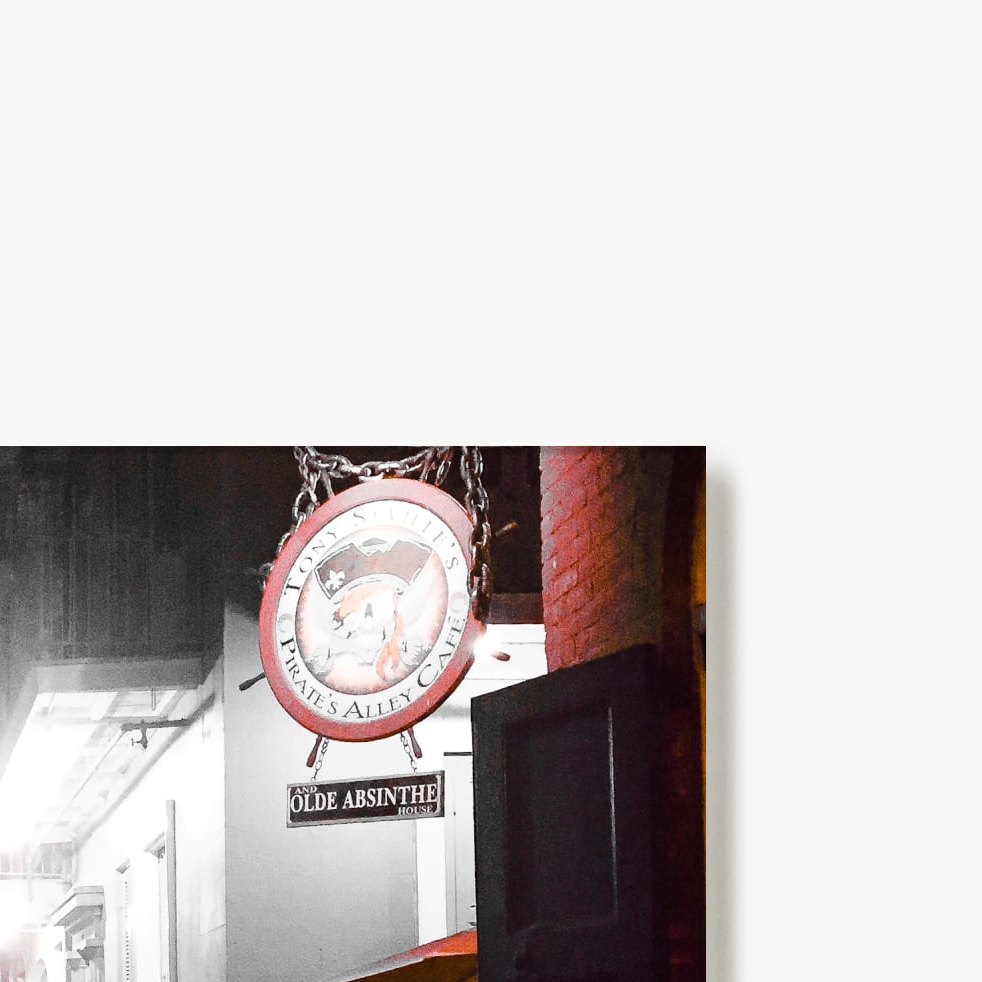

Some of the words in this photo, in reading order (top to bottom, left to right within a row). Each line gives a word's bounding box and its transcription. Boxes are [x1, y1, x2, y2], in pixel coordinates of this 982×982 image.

[284, 529, 338, 595] TONY
[353, 510, 460, 570] SIE'S
[280, 637, 338, 716] PIRATE'S
[345, 689, 412, 719] ALLEY
[290, 792, 338, 813] OLDE
[343, 783, 437, 809] ABSINTHE
[295, 786, 318, 795] AND
[398, 806, 433, 816] HOUSE
